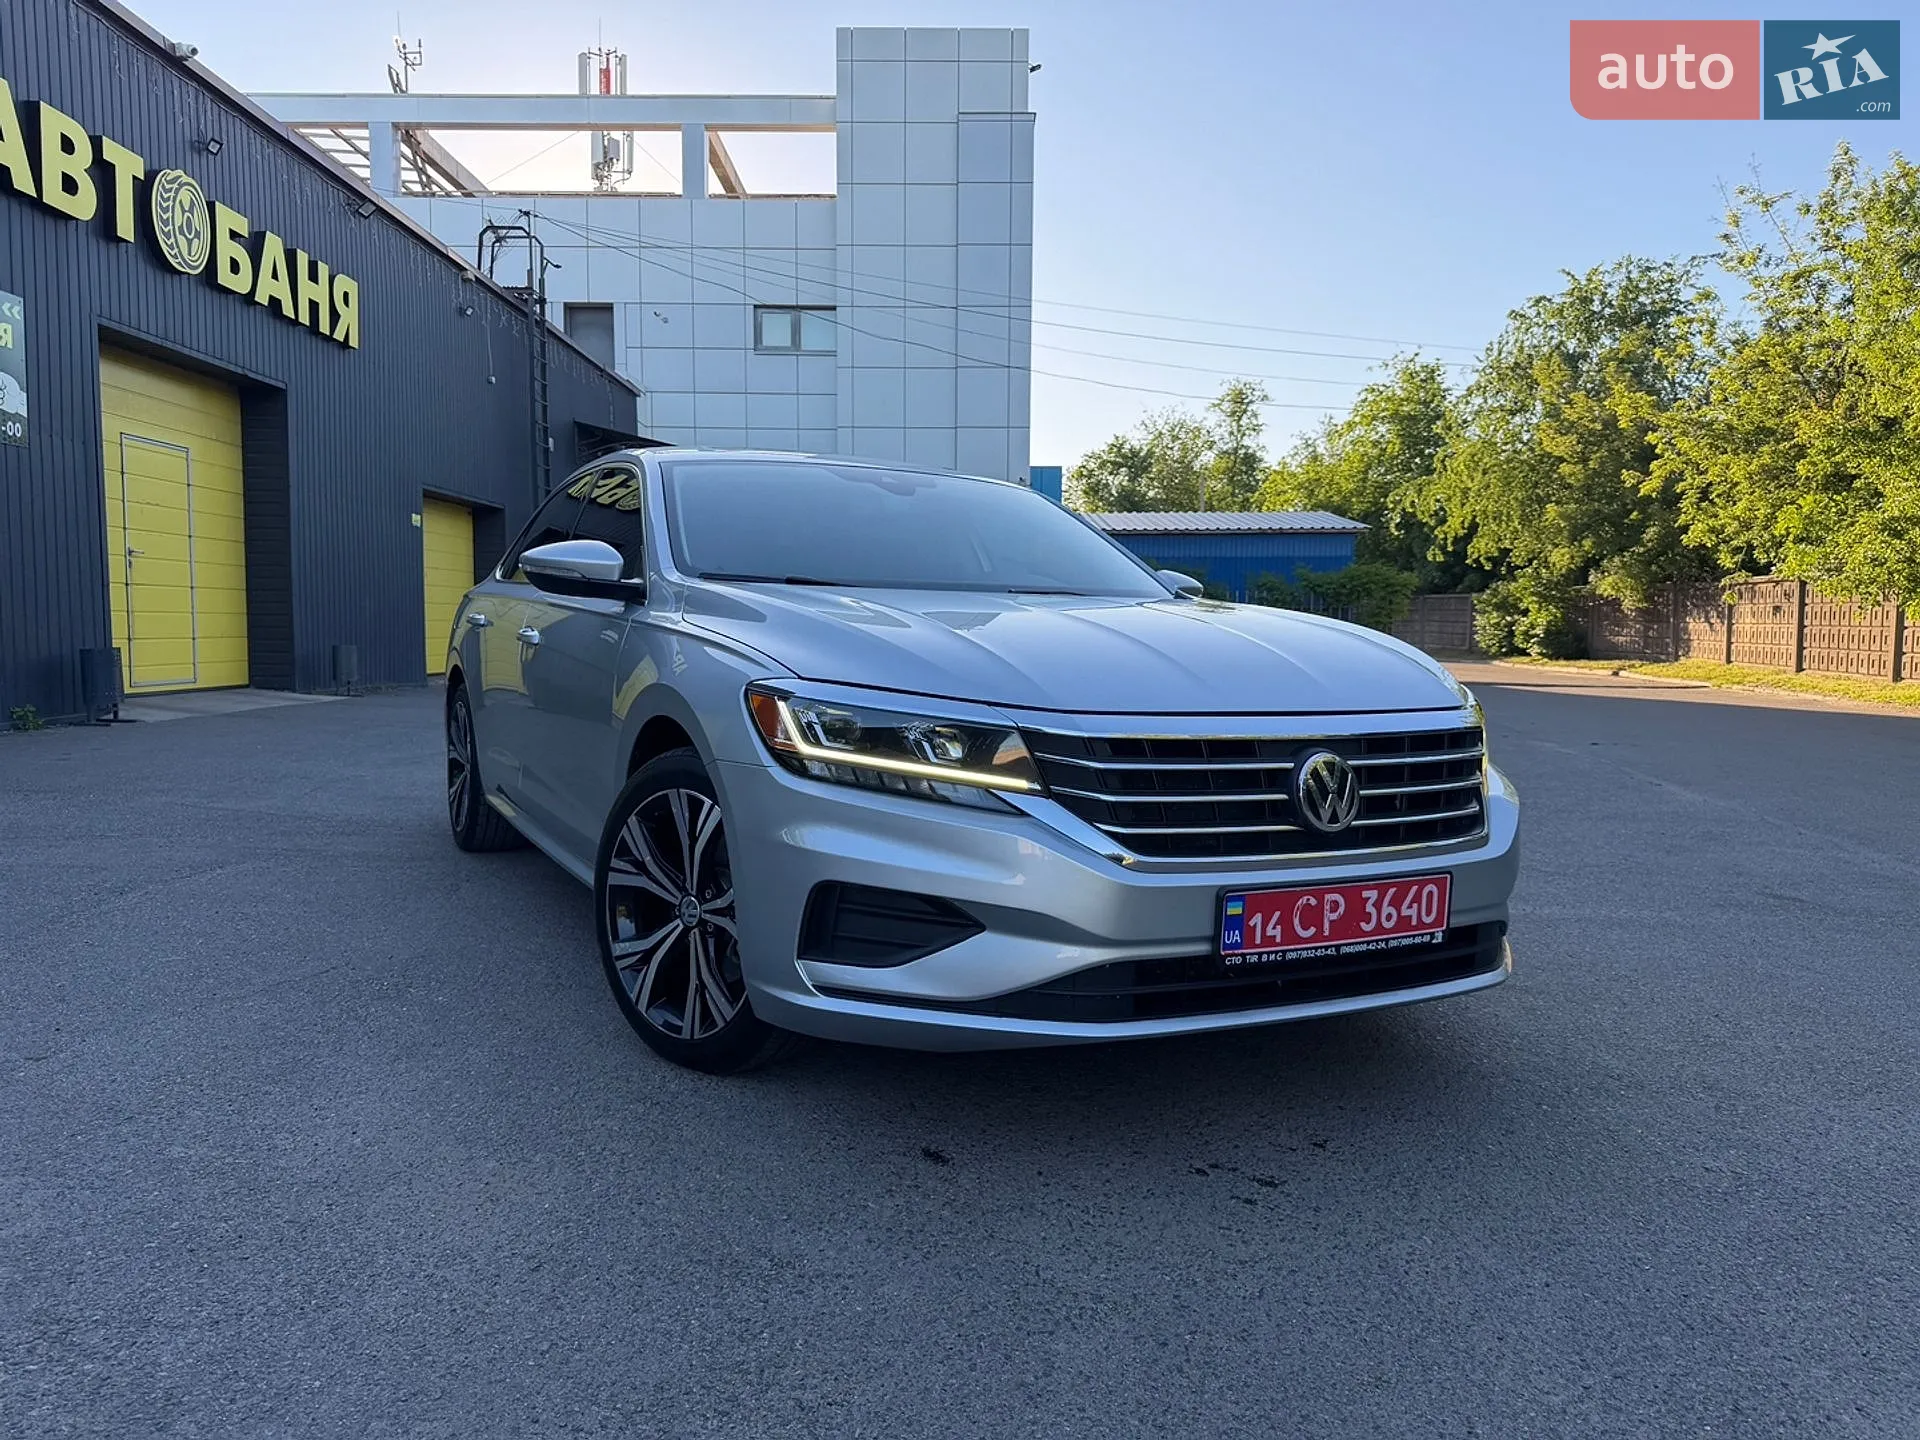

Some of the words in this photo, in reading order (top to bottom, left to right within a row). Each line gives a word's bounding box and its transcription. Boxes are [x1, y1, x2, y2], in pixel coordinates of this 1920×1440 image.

[1248, 910, 1282, 945] 14
[1359, 883, 1439, 932] 3640
[1224, 930, 1241, 944] UA
